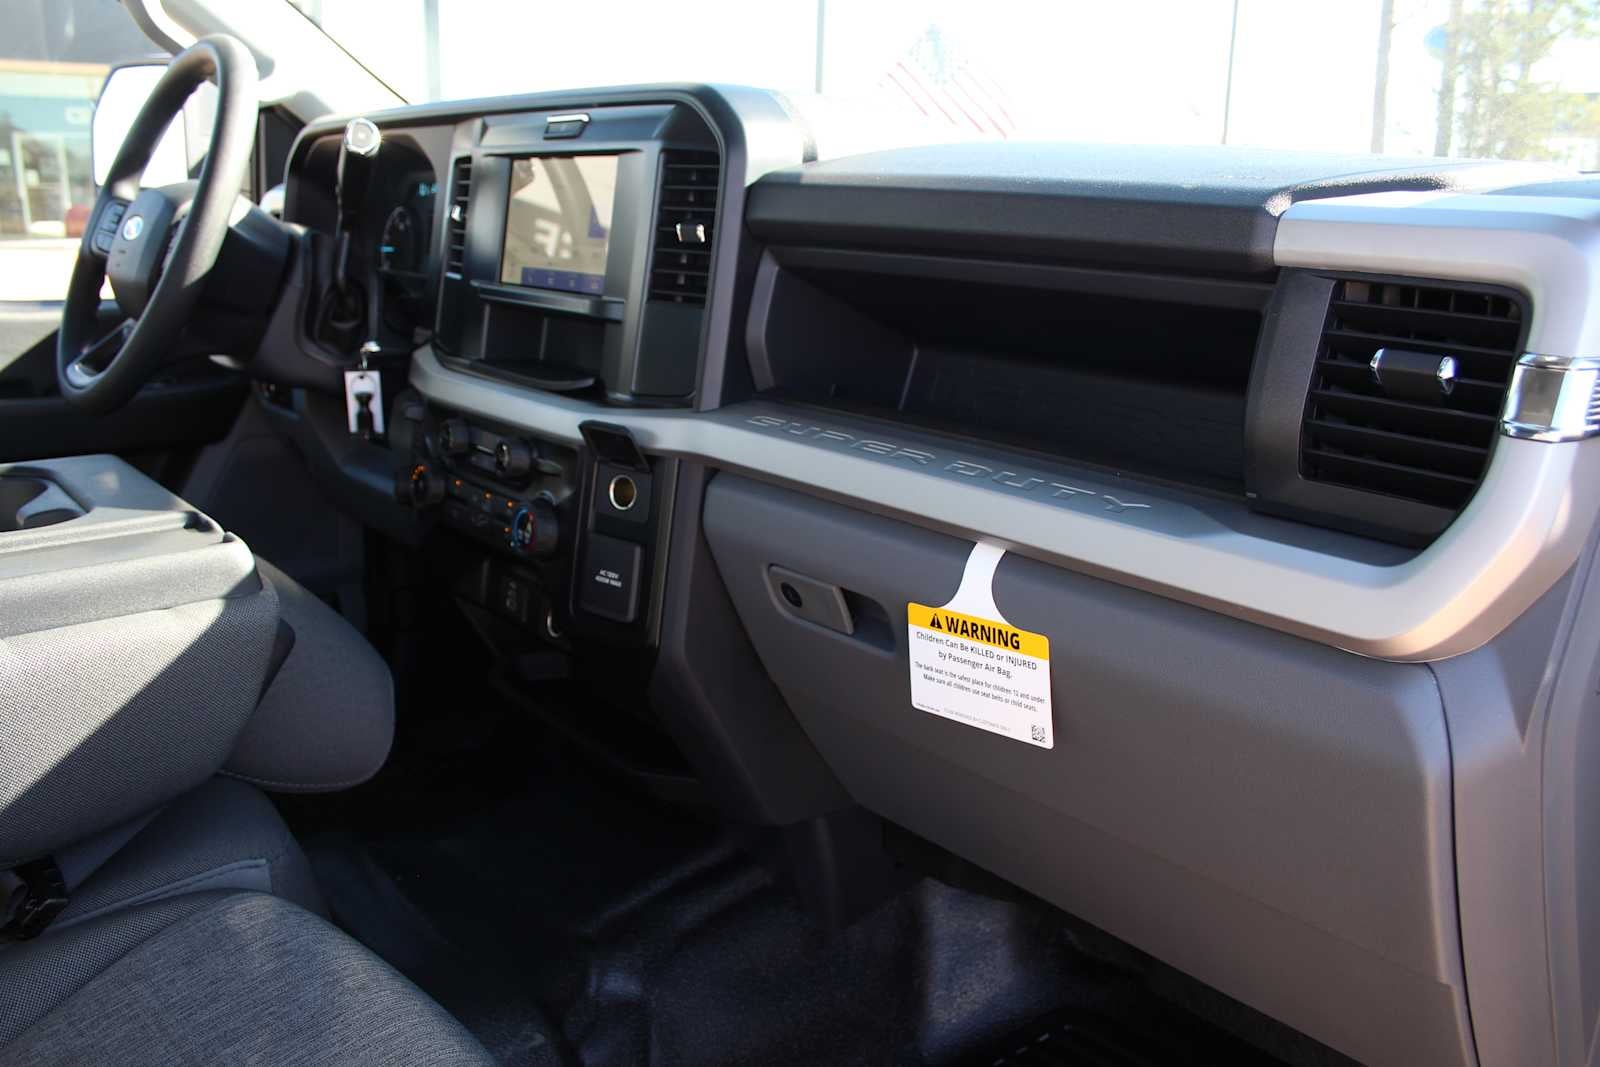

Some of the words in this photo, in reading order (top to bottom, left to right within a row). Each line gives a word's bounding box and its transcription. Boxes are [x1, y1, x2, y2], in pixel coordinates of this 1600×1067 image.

[745, 414, 937, 465] SUPER
[944, 459, 1152, 514] DUTY
[916, 631, 944, 644] Children
[945, 639, 959, 649] Can
[960, 642, 969, 652] Be
[970, 646, 995, 659] KILLED
[1006, 655, 1037, 670] INJURED
[945, 615, 1020, 650] WARNING
[938, 650, 948, 661] by
[948, 652, 983, 670] Passenger
[984, 663, 995, 672] Air
[923, 664, 934, 672] back
[934, 667, 944, 675] seat
[949, 671, 957, 679] the
[957, 673, 971, 683] safest
[971, 678, 984, 687] place
[984, 681, 992, 689] for
[992, 683, 1012, 695] children
[1020, 692, 1030, 700] and
[1030, 695, 1045, 704] under
[923, 673, 935, 682] Make
[936, 678, 946, 686] sure
[953, 682, 972, 693] children
[972, 688, 980, 696] use
[980, 690, 991, 698] seat
[991, 693, 1004, 703] belts
[1010, 698, 1023, 709] child
